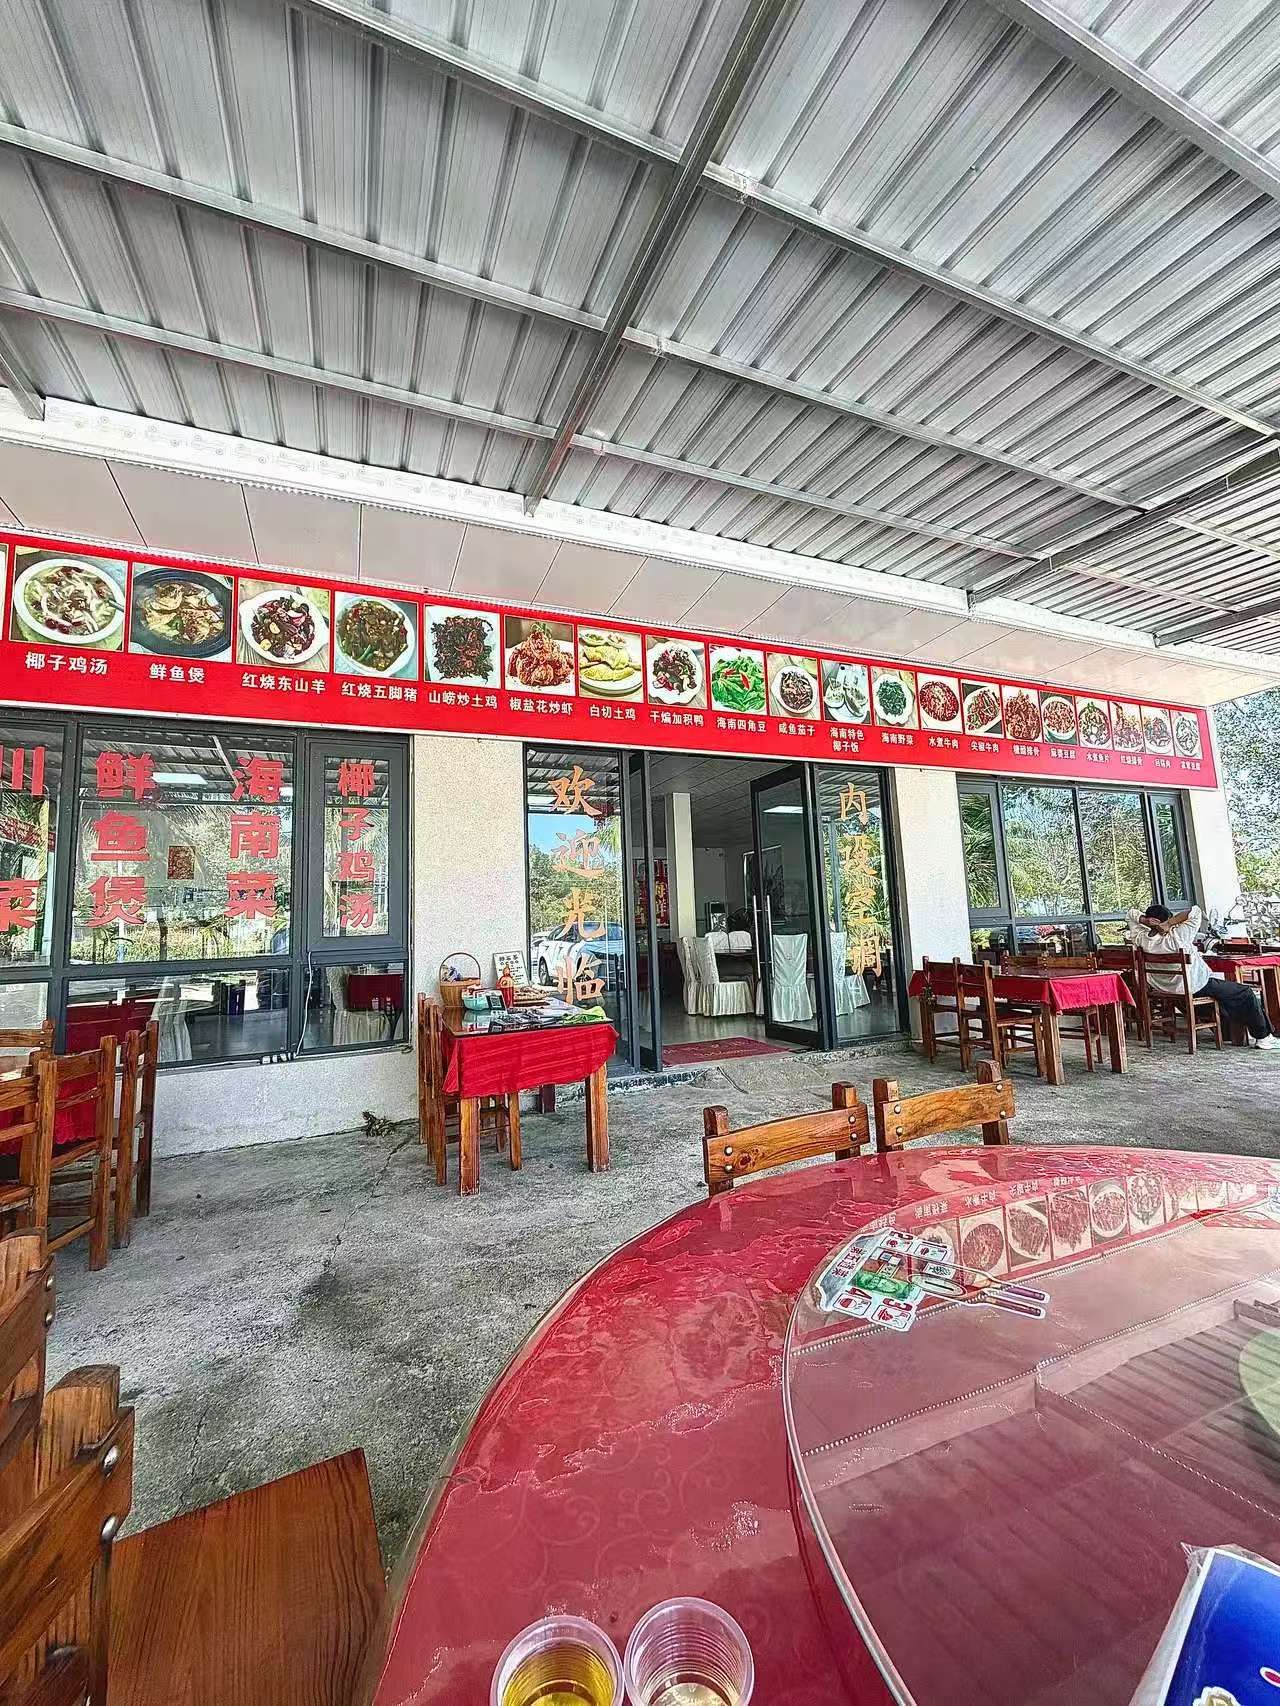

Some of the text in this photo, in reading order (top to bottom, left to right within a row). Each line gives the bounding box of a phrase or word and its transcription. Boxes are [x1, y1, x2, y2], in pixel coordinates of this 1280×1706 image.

[25, 650, 109, 676] 椰子鸡汤
[149, 662, 206, 684] 鲜鱼煲
[241, 672, 327, 695] 红烧东山羊
[341, 681, 418, 703] 红烧五脚猪
[509, 697, 574, 716] 椒盐花炒虾
[590, 705, 636, 721] 白切土鸡
[650, 710, 704, 727] 干煸加积鸭
[716, 716, 767, 733] 海南四角豆
[778, 722, 816, 737] 咸鱼茄子
[830, 726, 865, 741] 海南特色
[881, 731, 914, 746] 海南野菜
[832, 740, 860, 754] 椰子饭
[928, 736, 959, 749] 水煮牛肉
[970, 740, 999, 753] 尖椒牛肉
[87, 751, 157, 928] 鲜鱼煲
[224, 755, 286, 920] 海南菜
[335, 760, 376, 930] 椰子鸡汤
[548, 765, 606, 1004] 欢迎光临
[838, 782, 886, 978] 内设空调
